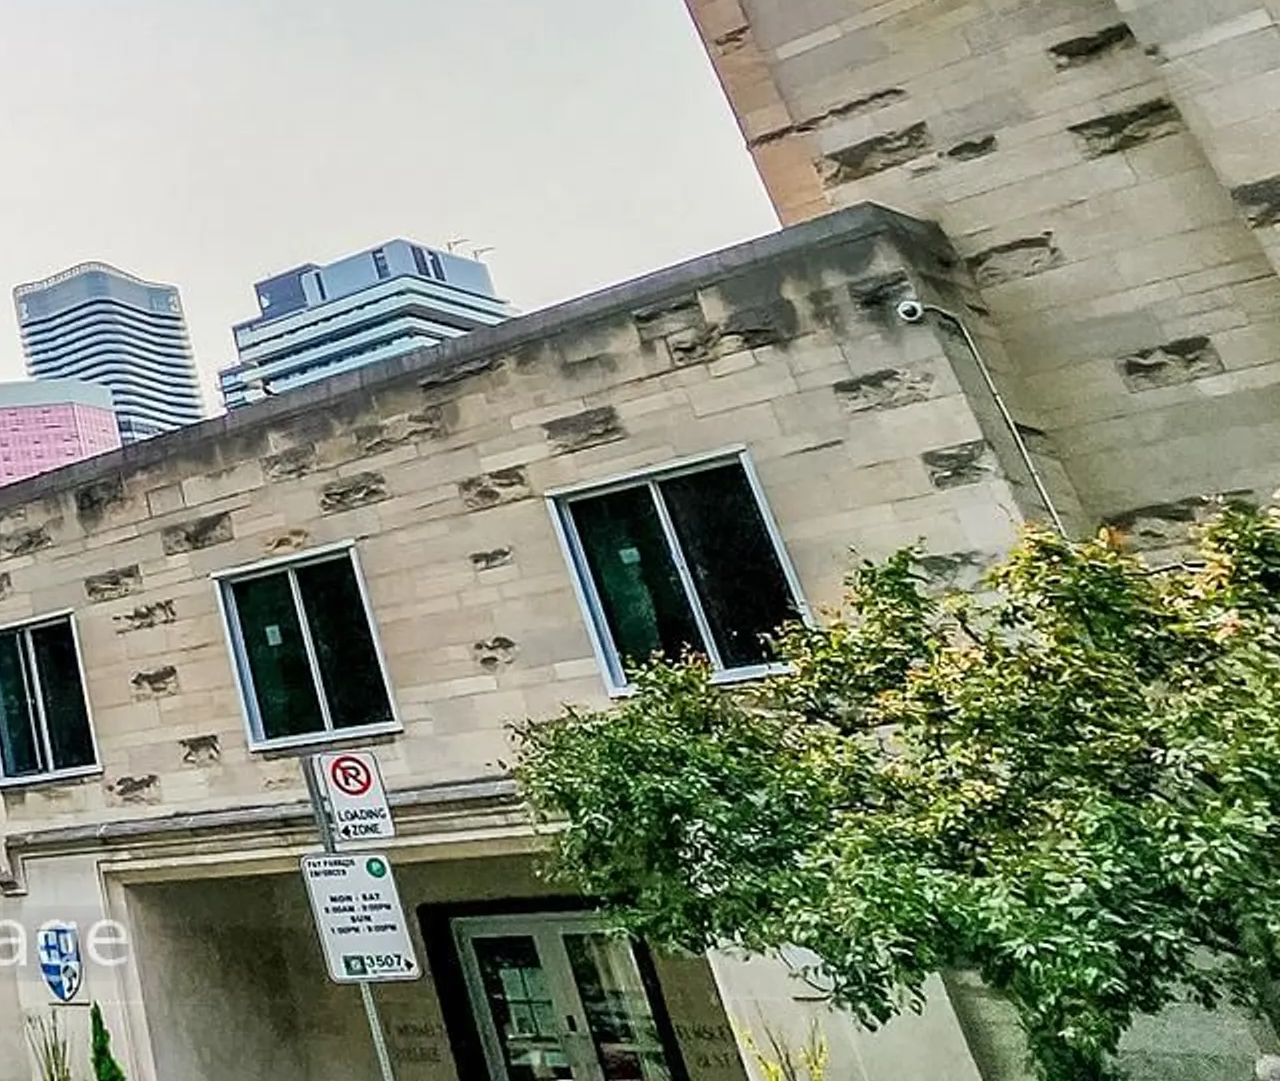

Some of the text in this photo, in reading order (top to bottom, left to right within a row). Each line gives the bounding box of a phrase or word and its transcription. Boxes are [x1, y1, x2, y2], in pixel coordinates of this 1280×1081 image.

[338, 807, 387, 822] LOADING
[351, 823, 382, 836] ZONE
[366, 955, 402, 968] 3507
